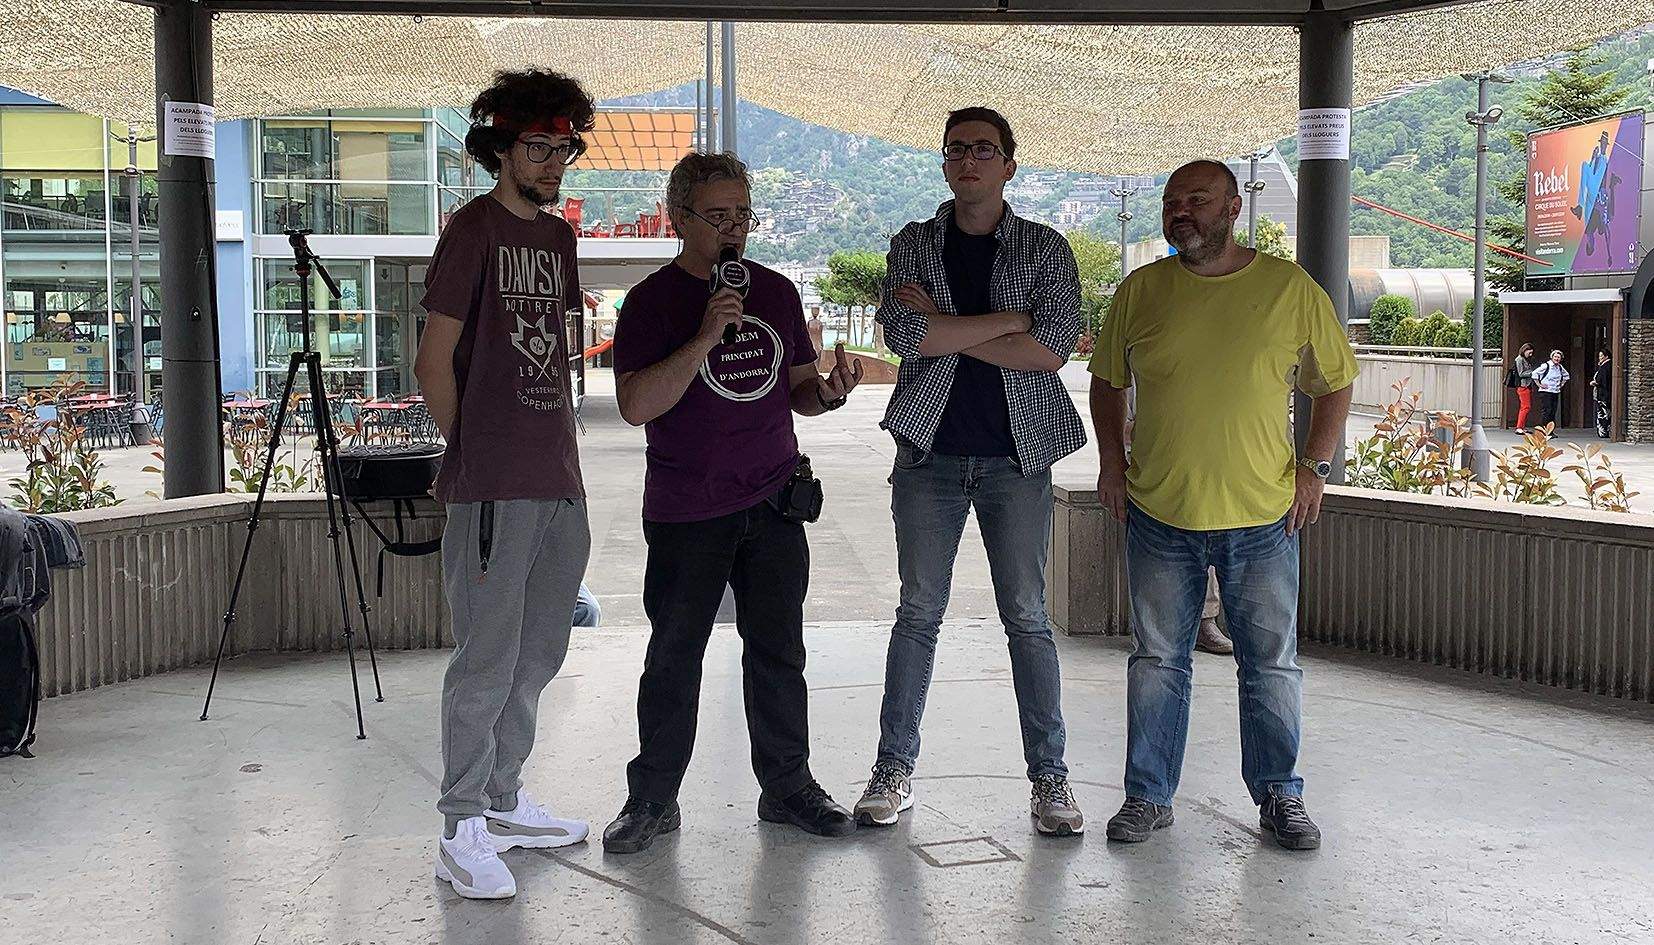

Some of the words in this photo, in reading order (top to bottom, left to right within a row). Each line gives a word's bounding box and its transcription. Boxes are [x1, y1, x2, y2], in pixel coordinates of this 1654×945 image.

[1534, 165, 1570, 196] Rebel
[499, 246, 562, 296] DANSK
[721, 349, 764, 361] PRINCIPAT
[720, 368, 769, 380] D'ANDORRA
